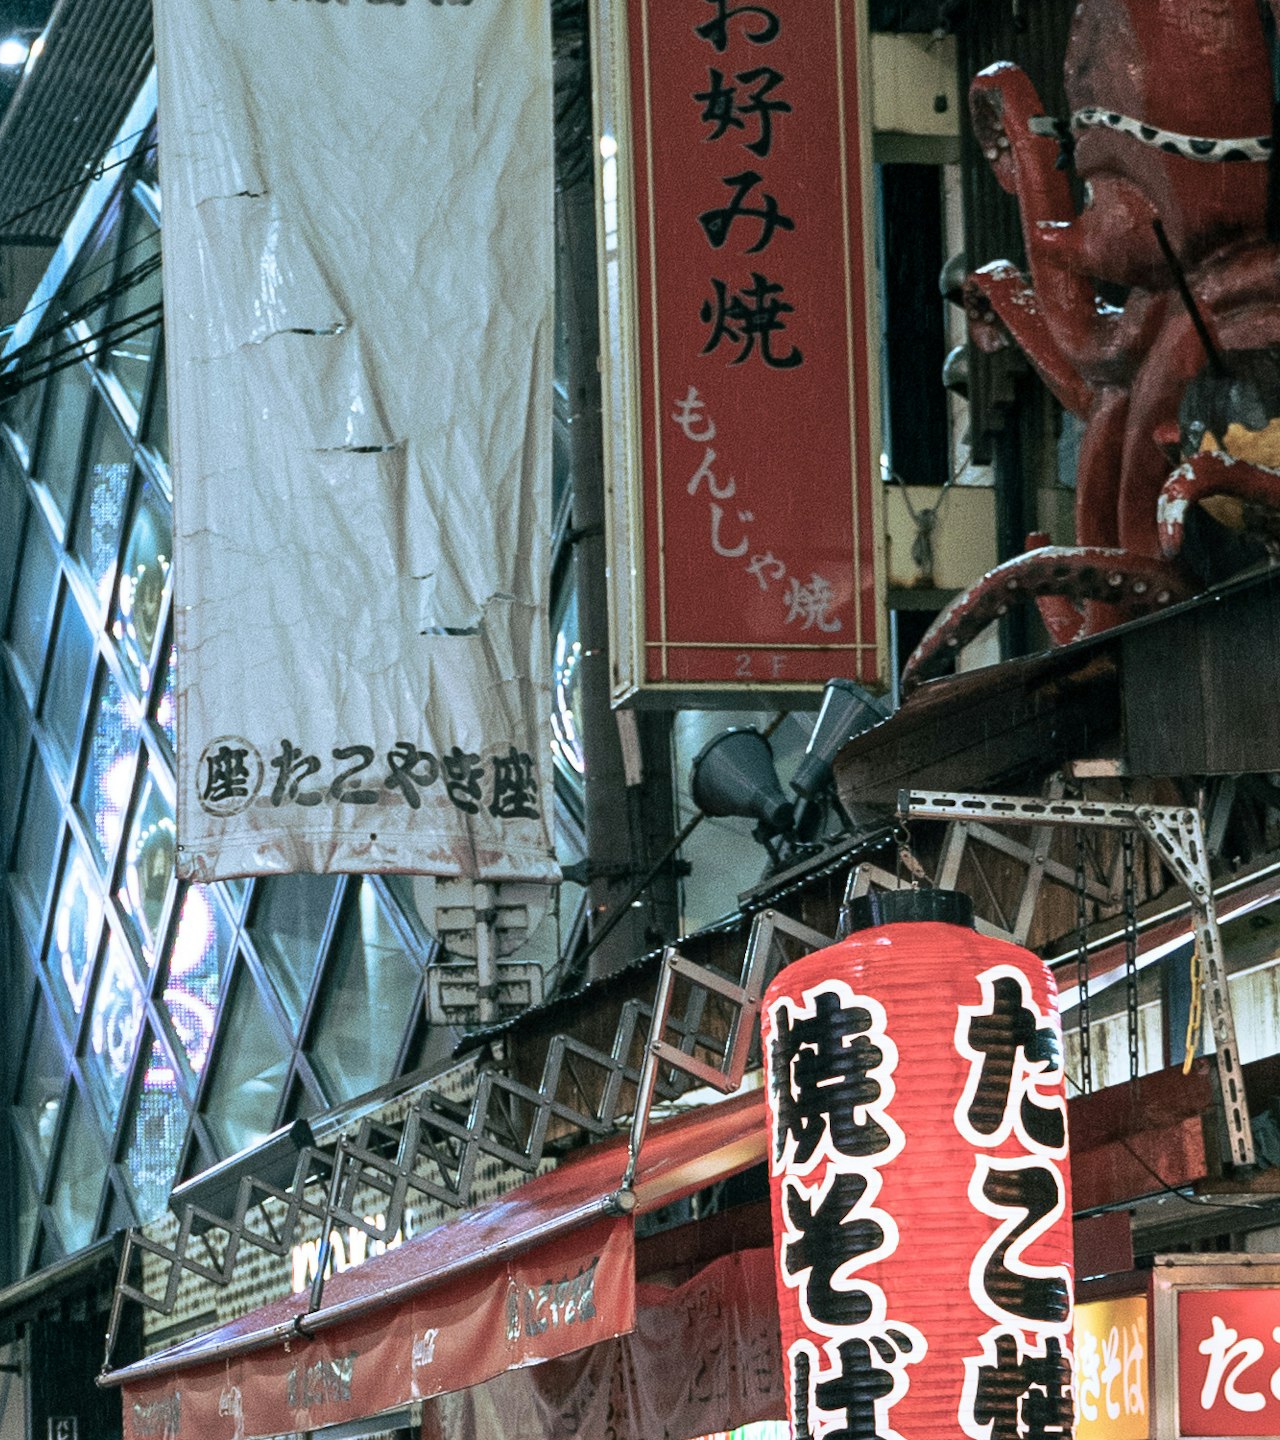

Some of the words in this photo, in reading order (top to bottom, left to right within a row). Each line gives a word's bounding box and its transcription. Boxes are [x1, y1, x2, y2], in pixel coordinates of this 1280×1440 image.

[672, 385, 840, 636] もんじゃ焼
[1198, 1315, 1280, 1412] た
